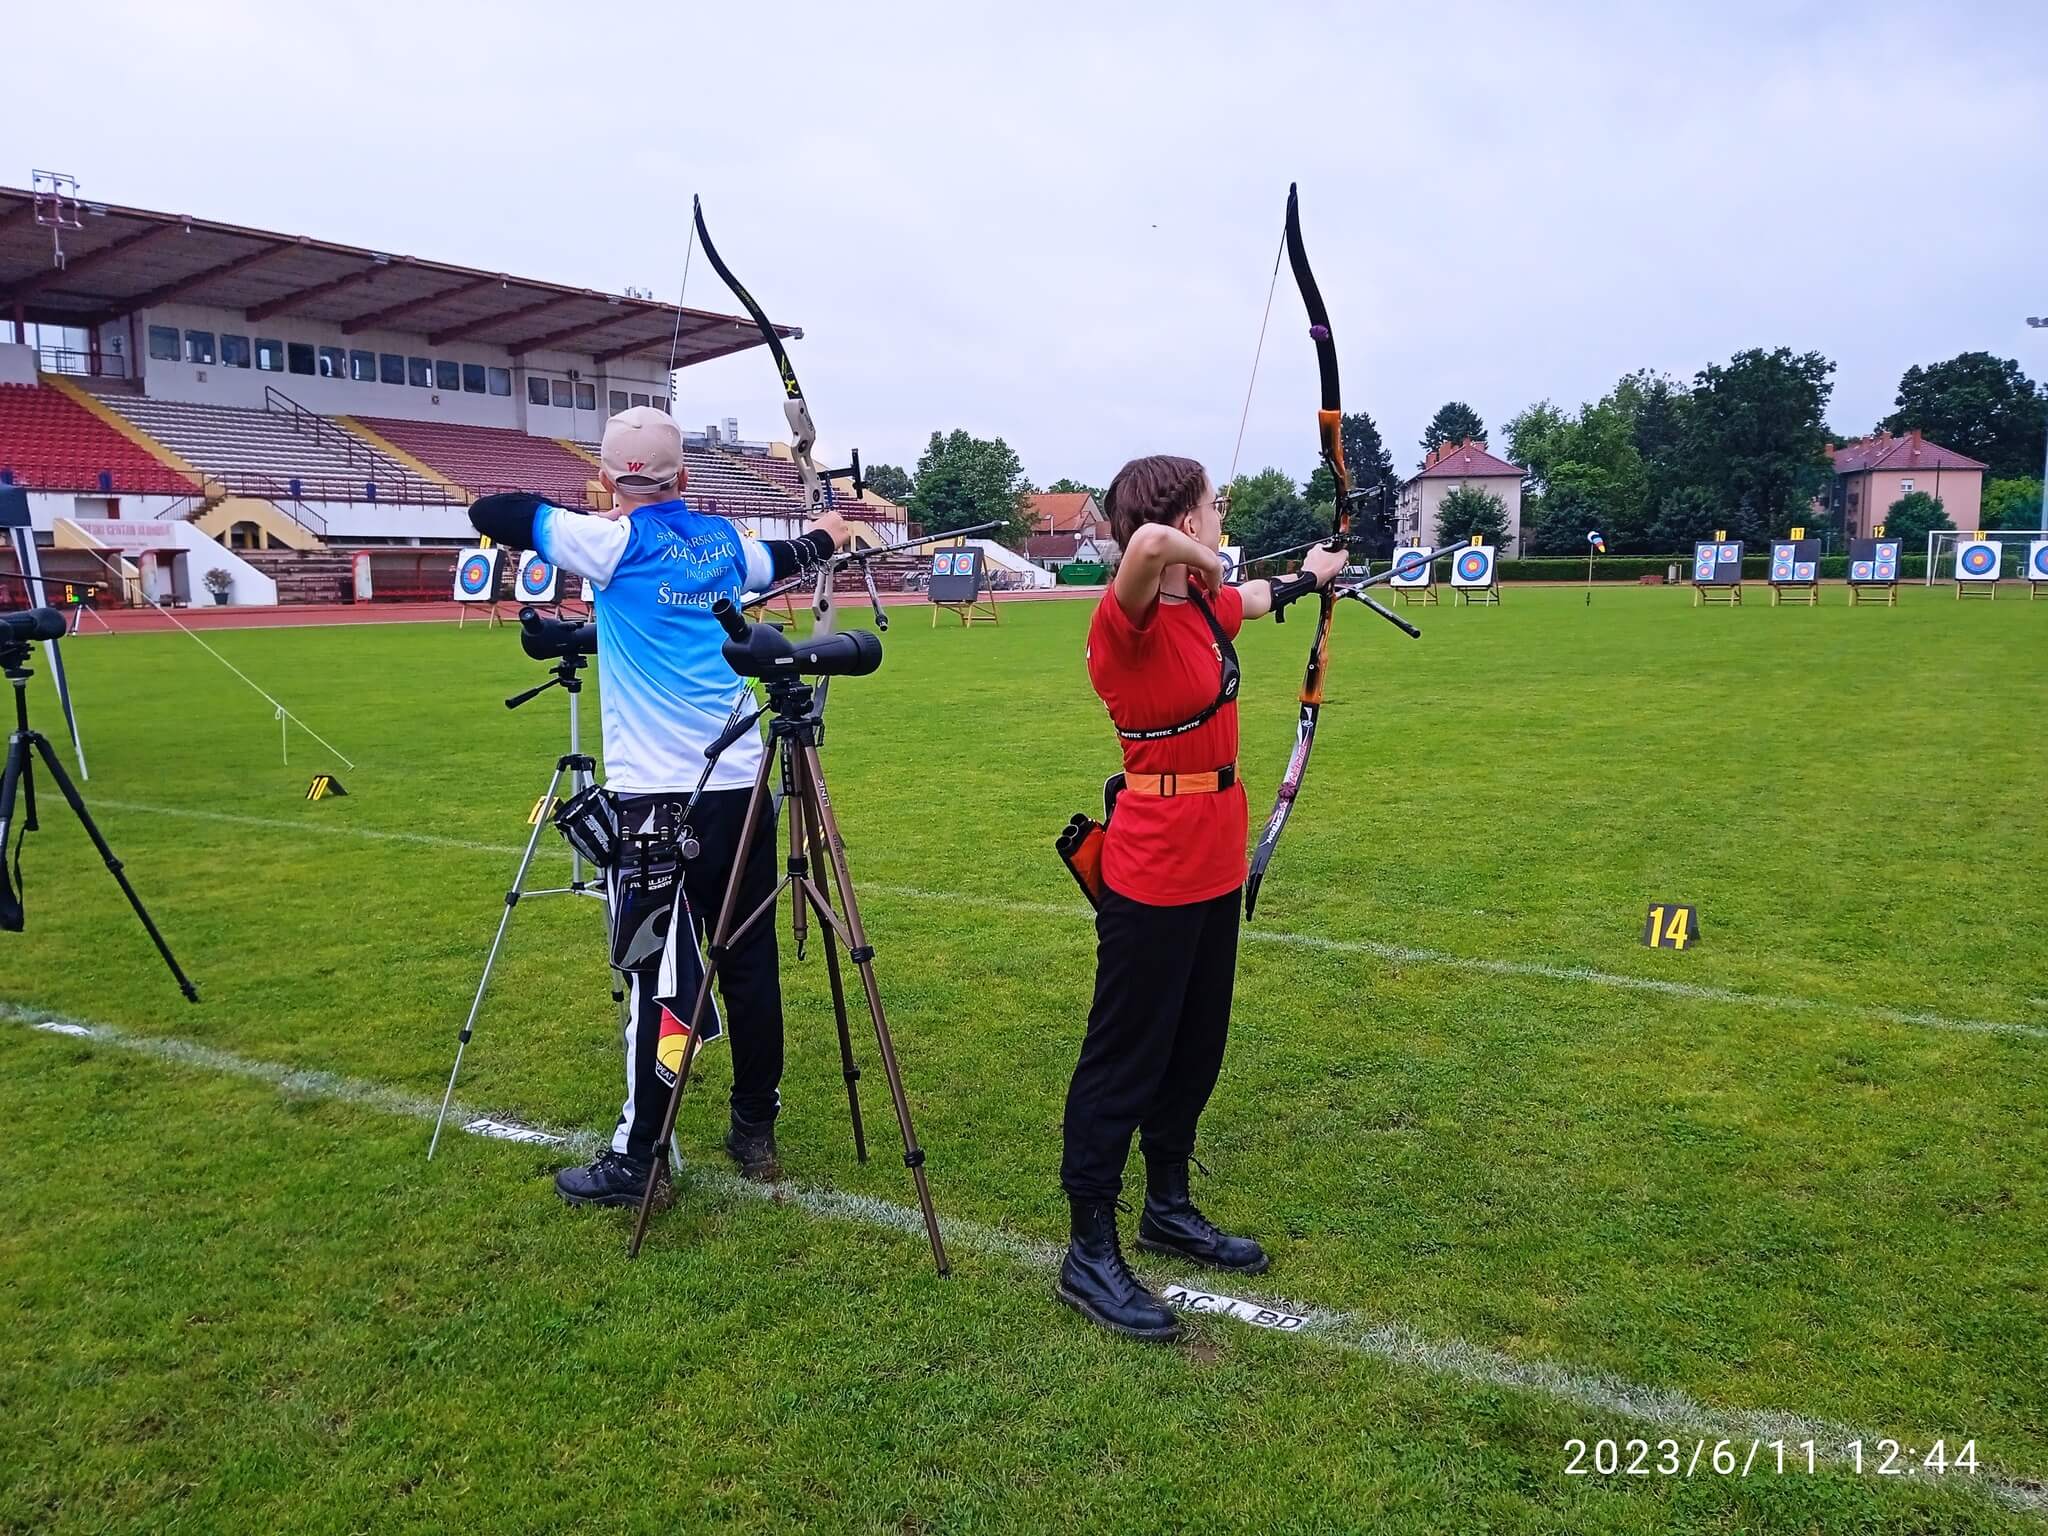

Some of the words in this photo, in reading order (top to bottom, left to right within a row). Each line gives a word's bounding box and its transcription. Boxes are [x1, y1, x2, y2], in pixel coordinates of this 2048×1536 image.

[627, 462, 644, 472] W
[1715, 530, 1726, 542] 10
[1874, 526, 1885, 538] 12
[307, 776, 329, 801] 10
[818, 778, 830, 807] LINK
[1650, 906, 1689, 950] 14
